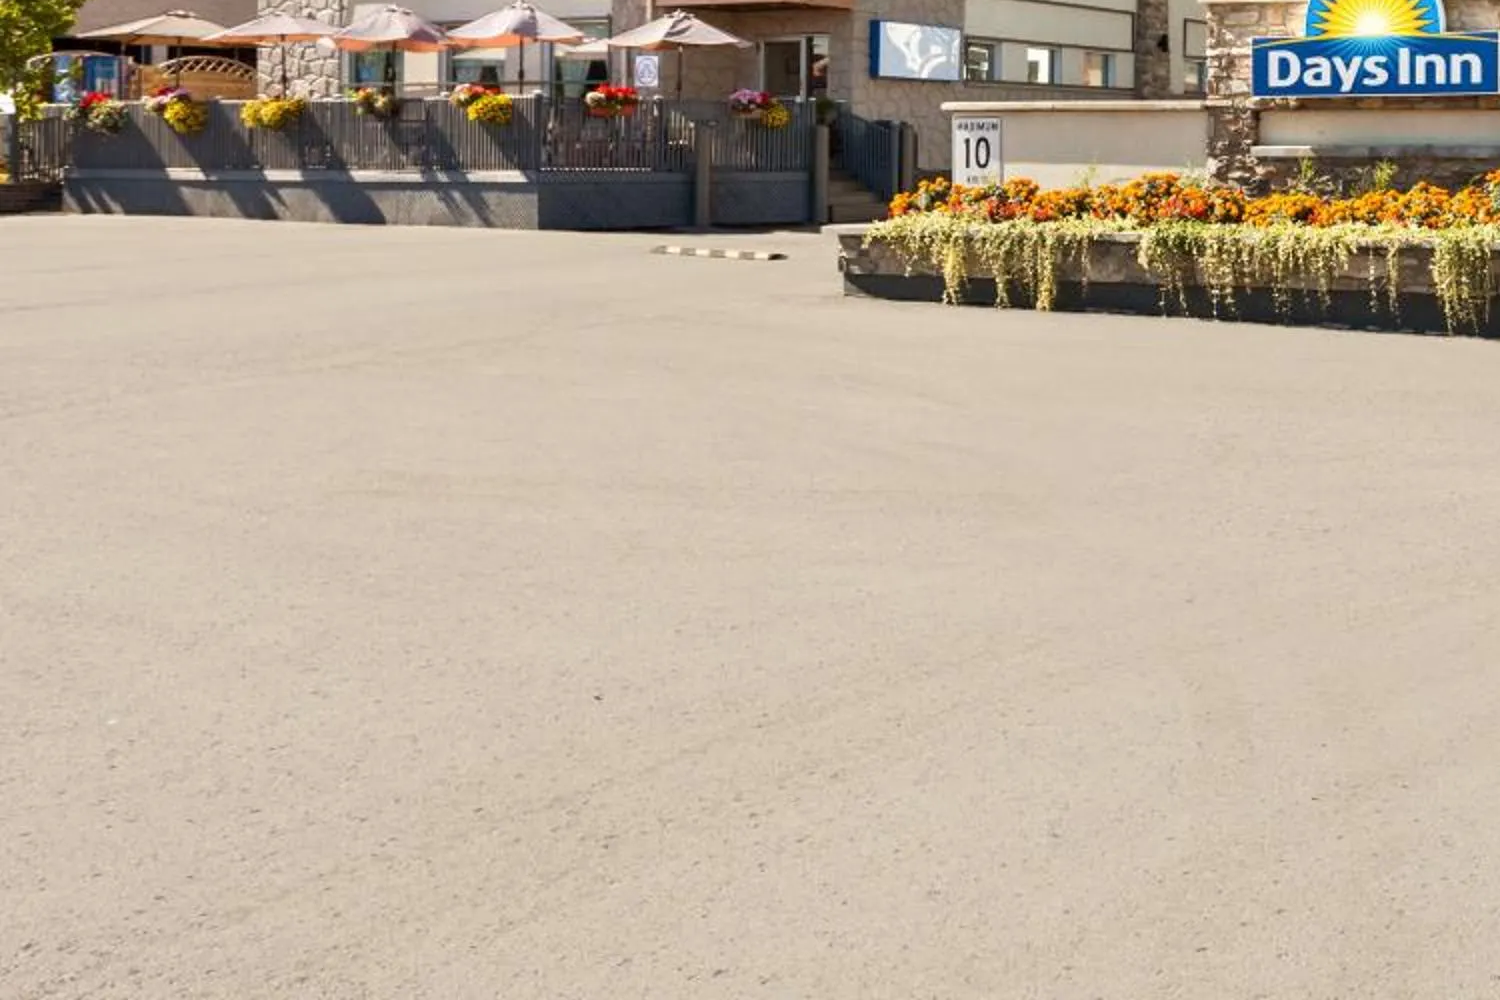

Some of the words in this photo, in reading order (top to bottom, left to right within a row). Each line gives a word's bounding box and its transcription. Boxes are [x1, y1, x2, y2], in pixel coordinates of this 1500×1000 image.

[1267, 50, 1389, 92] Days
[1398, 47, 1482, 85] Inn
[964, 137, 991, 169] 10
